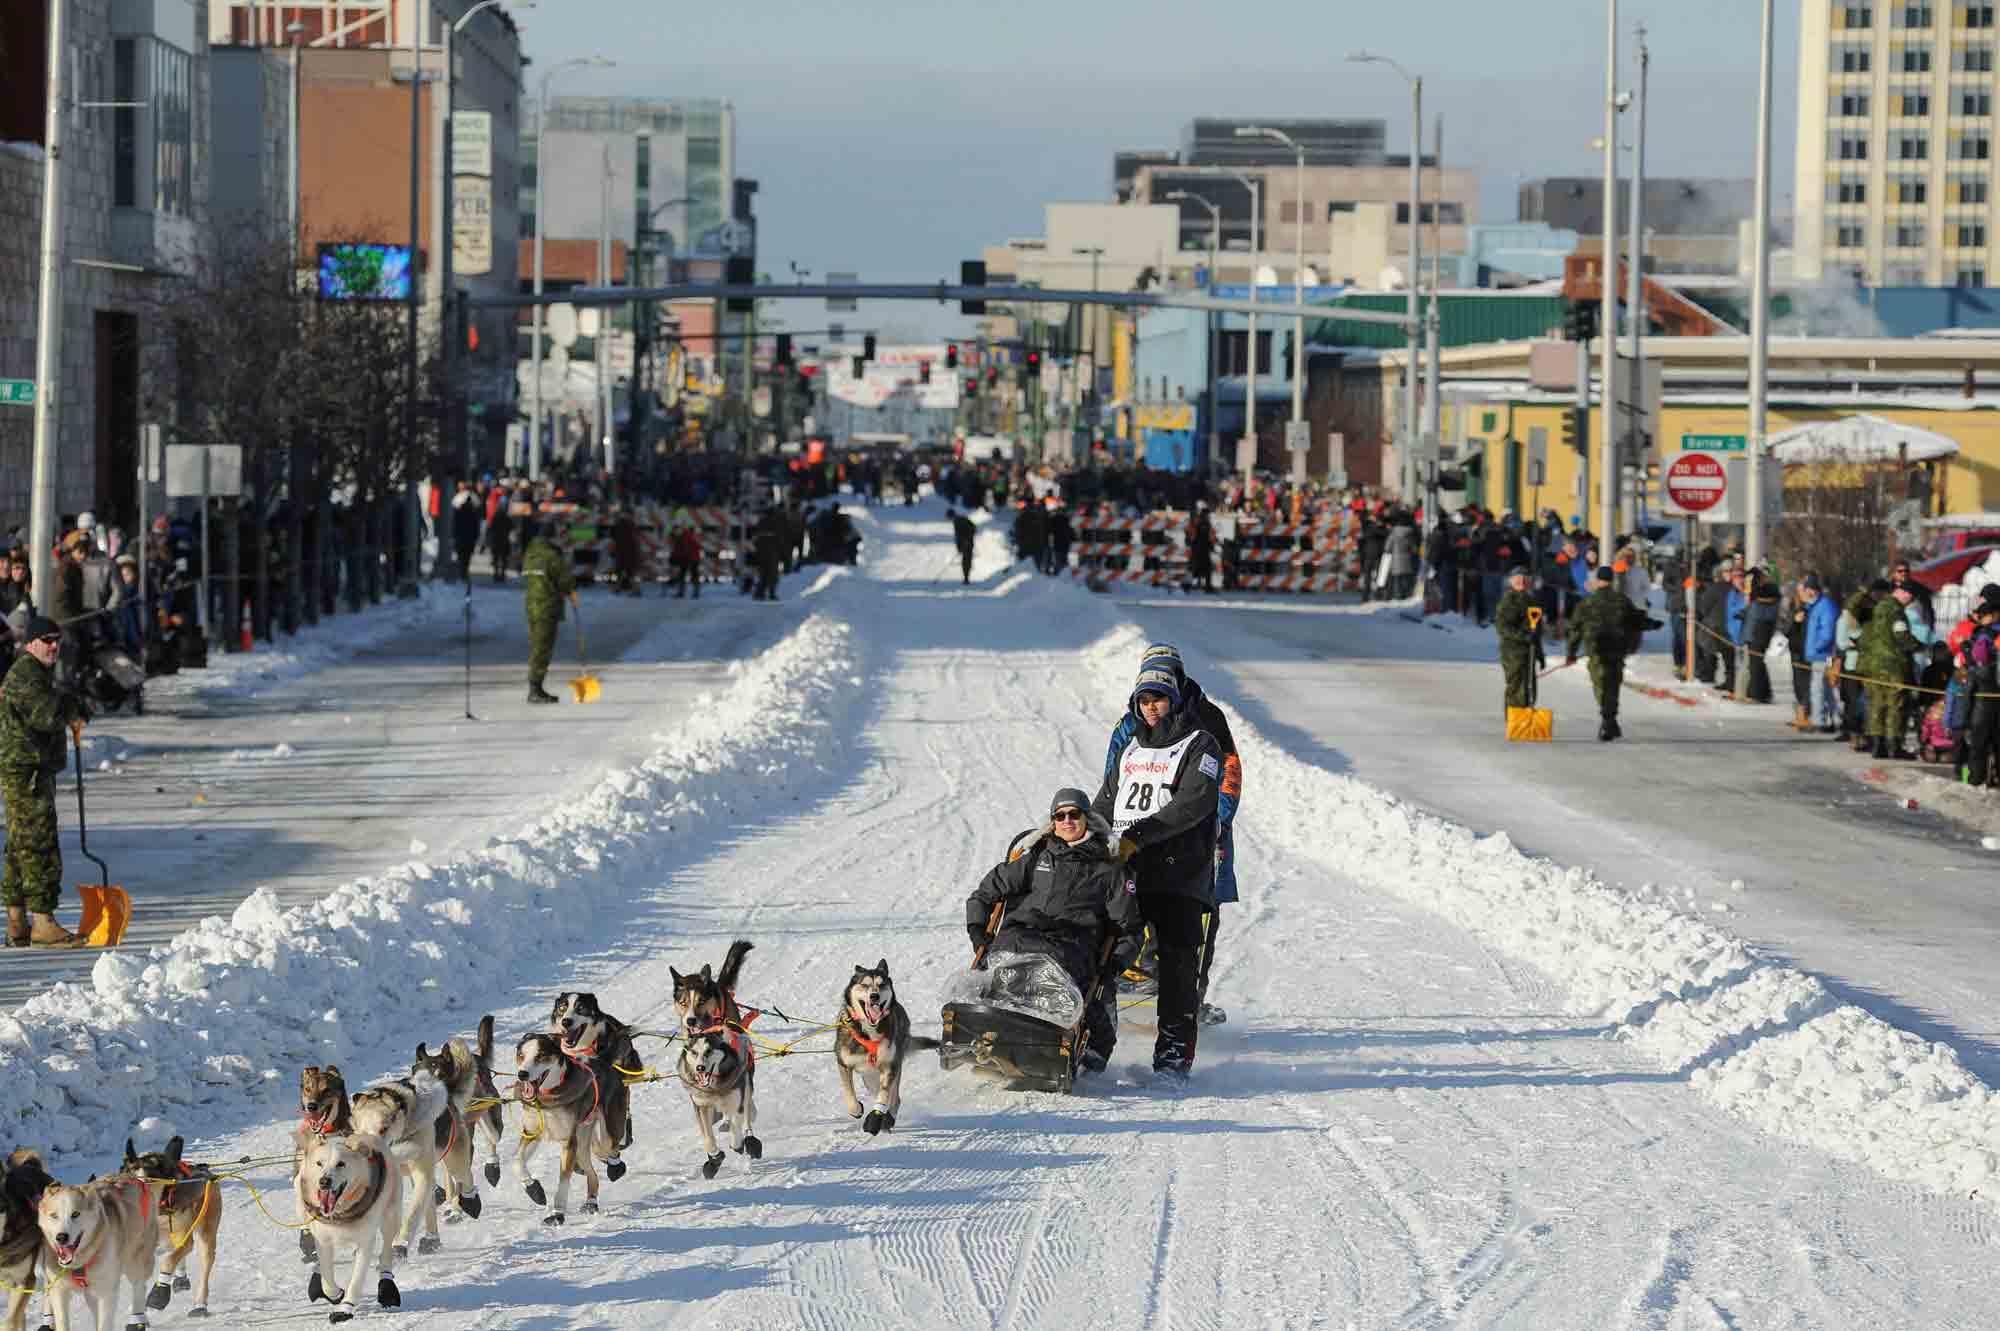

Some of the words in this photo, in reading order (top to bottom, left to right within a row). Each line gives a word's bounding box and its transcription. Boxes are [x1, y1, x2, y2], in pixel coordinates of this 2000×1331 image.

[1675, 464, 1691, 474] DO
[1696, 464, 1718, 474] NOT
[1680, 490, 1713, 500] ENTER
[1125, 782, 1153, 811] 28
